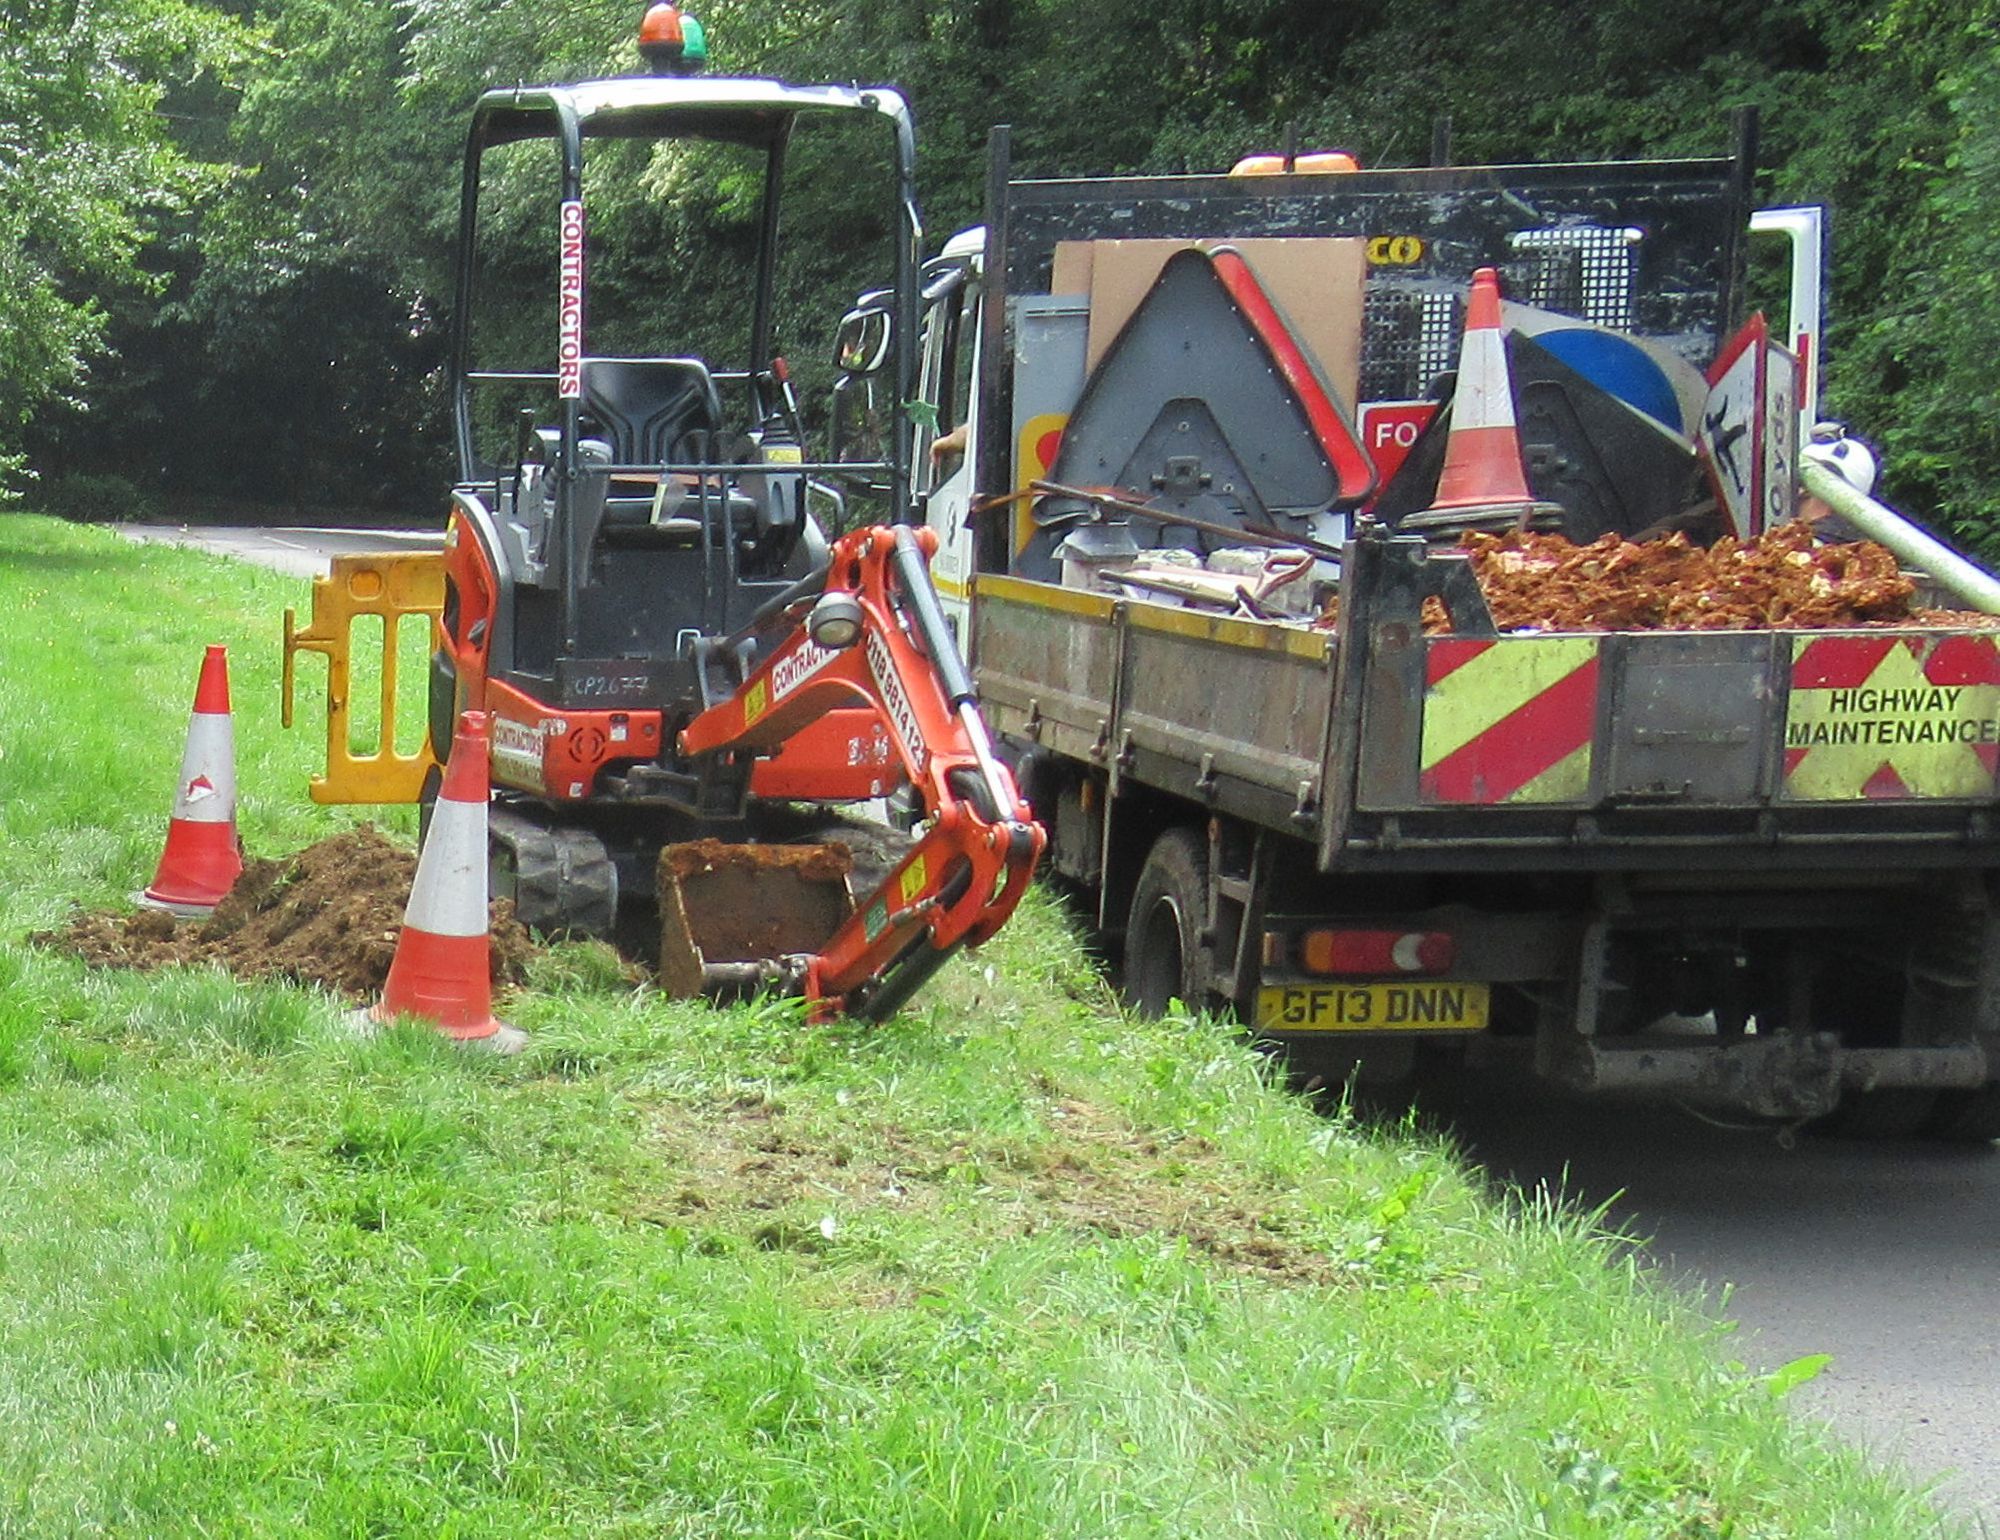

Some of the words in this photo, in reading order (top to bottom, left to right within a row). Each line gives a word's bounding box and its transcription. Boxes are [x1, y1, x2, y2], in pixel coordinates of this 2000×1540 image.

[560, 204, 582, 395] CONTRACTORS
[1375, 422, 1418, 448] FO
[1829, 688, 1962, 714] HIGHWAY
[1787, 719, 1997, 746] MAINTENANCE
[1283, 988, 1372, 1023] GF13
[1386, 988, 1465, 1022] DNN
